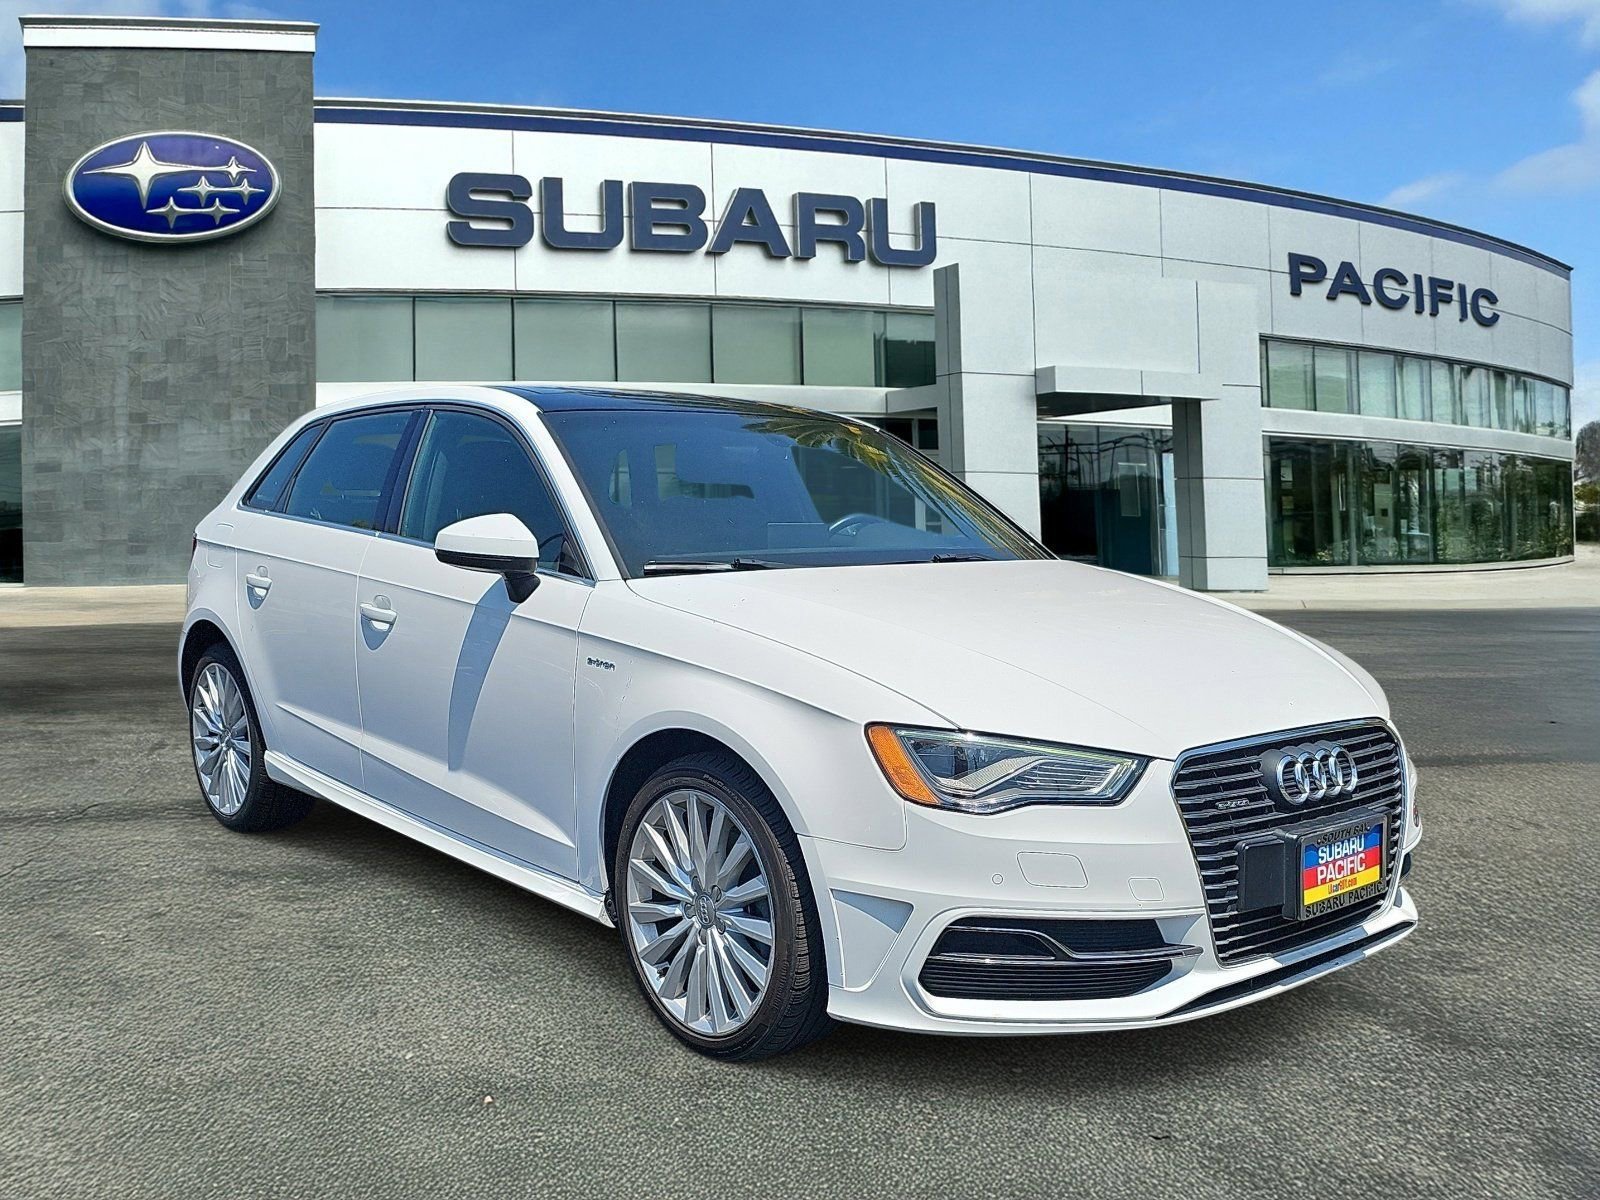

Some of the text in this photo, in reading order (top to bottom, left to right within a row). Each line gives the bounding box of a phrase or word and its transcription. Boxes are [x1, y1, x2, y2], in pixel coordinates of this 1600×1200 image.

[446, 171, 937, 268] SUBARU
[1288, 252, 1501, 327] PACIFIC
[1318, 834, 1365, 864] SUBARU
[1321, 827, 1352, 844] SOUTH
[1317, 853, 1366, 885] PACIFIC
[1305, 880, 1384, 918] SUBARU PACIFIC
